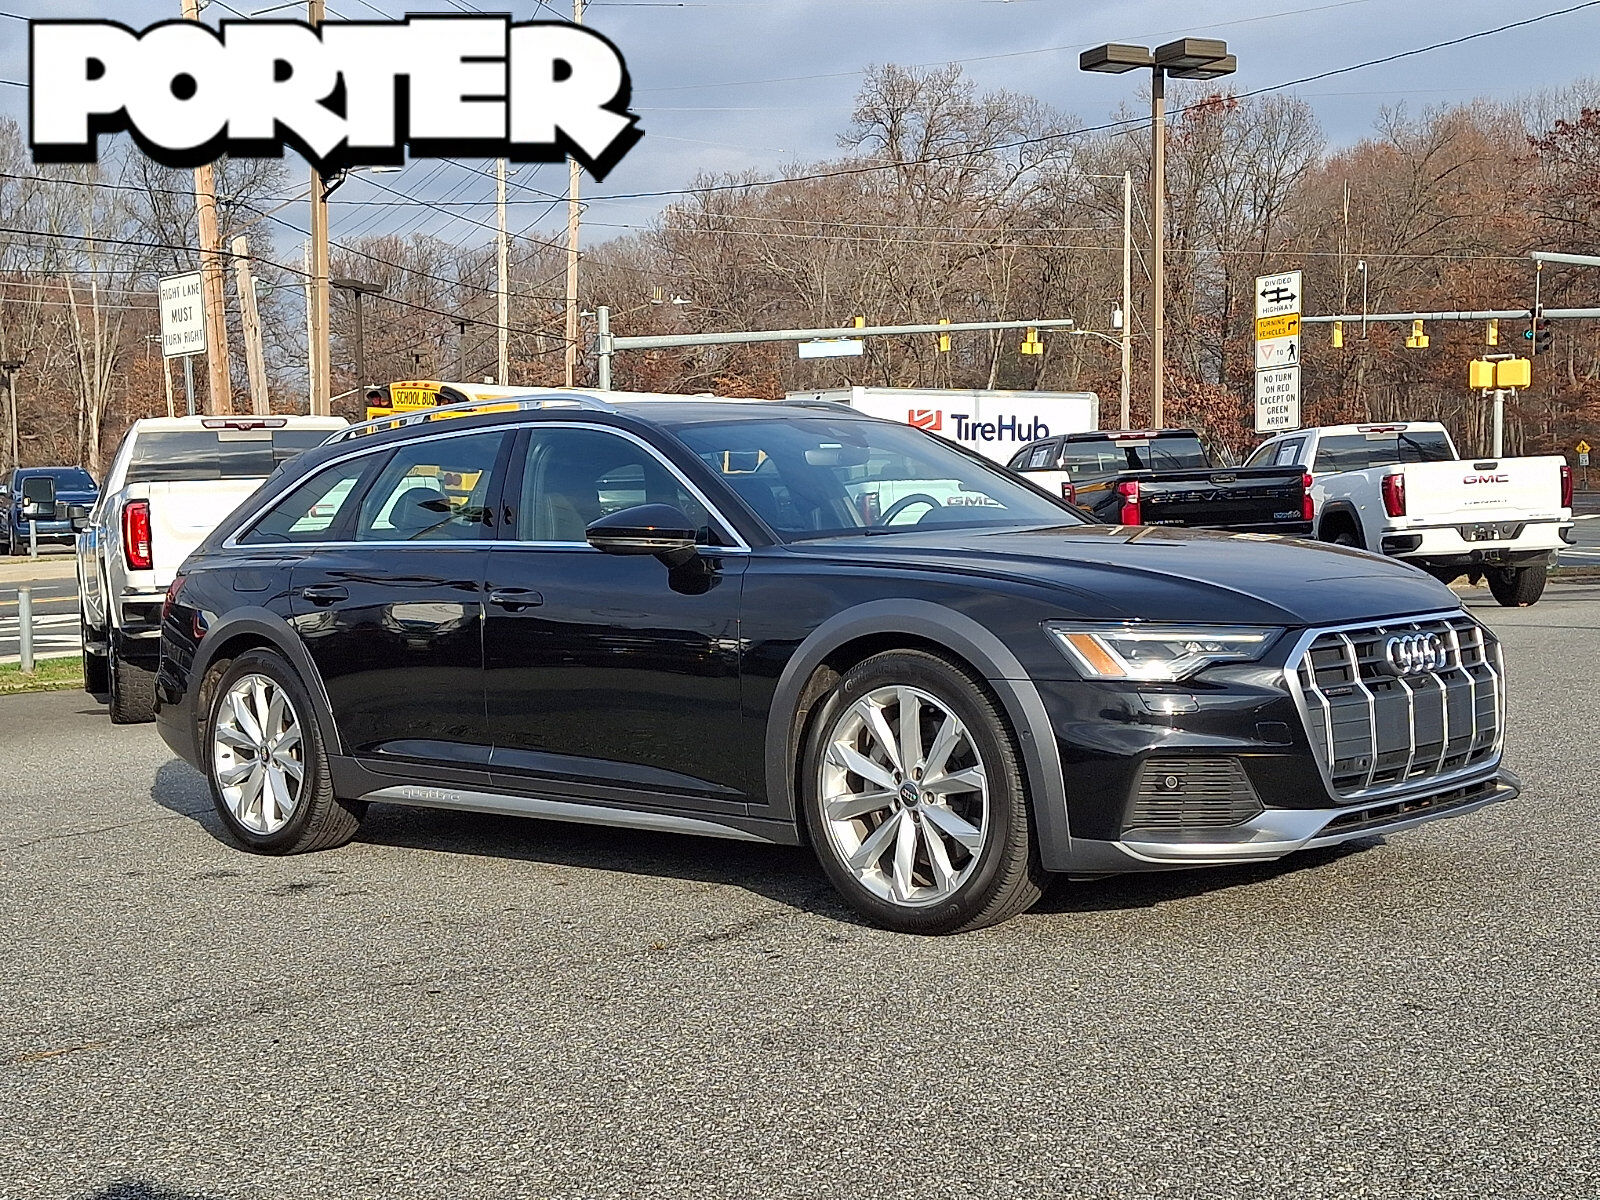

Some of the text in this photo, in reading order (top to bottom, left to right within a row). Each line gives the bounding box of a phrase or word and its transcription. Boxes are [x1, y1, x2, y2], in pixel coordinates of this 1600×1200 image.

[1264, 277, 1292, 287] DIVIDED
[162, 282, 200, 301] RIGHT LANE
[1262, 303, 1293, 314] HIGHWAY
[171, 306, 193, 323] MUST
[1260, 318, 1286, 328] TURNING
[165, 329, 203, 346] TURN RIGHT
[1259, 327, 1286, 337] VEHICLES
[1263, 372, 1292, 384] NO TURN
[1265, 383, 1290, 394] ON RED
[396, 390, 435, 406] SCHOOL BUS
[1260, 393, 1296, 406] EXCEPT ON
[1266, 405, 1289, 415] GREEN
[1266, 416, 1289, 425] ARROW
[950, 413, 1050, 441] TireHub
[1463, 474, 1510, 484] GMC
[947, 496, 1000, 506] GMC
[402, 787, 461, 802] quattro
